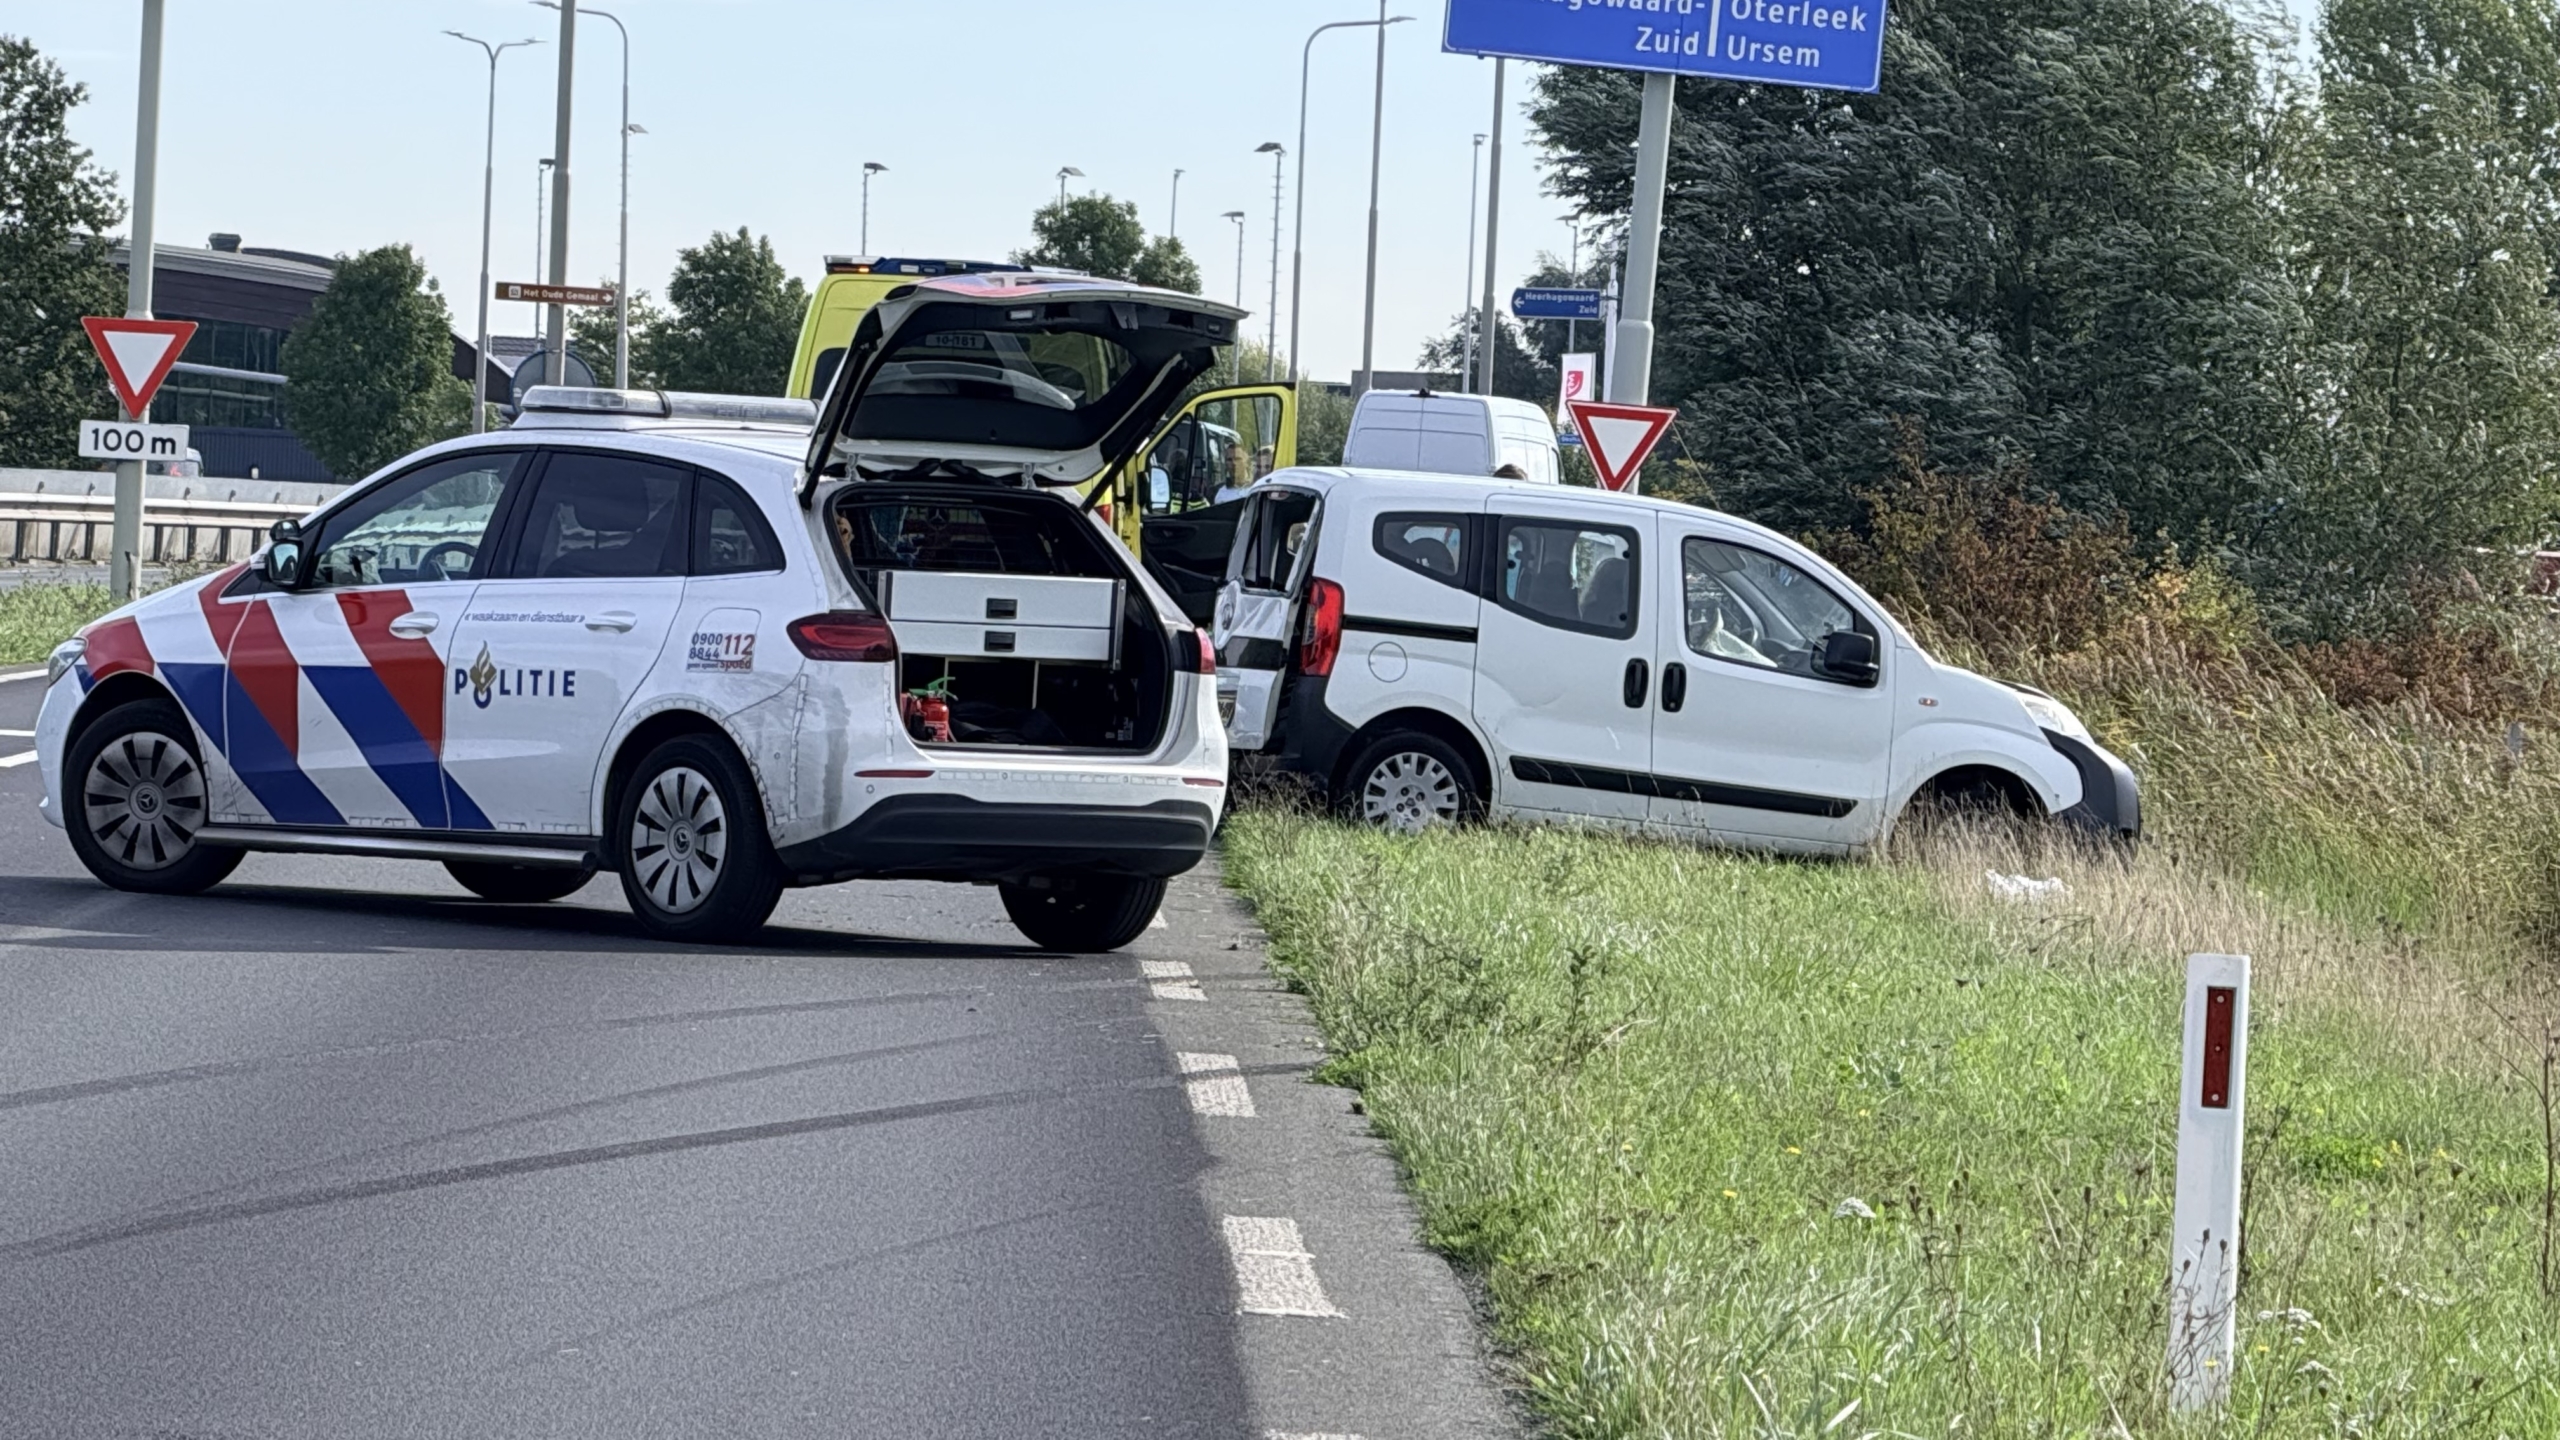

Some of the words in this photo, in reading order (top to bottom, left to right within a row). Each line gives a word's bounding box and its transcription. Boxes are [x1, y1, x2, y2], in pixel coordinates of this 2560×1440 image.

[1731, 0, 1868, 32] Oterleek
[1635, 26, 1699, 55] Zuid
[1727, 35, 1820, 68] Ursem
[523, 289, 539, 297] Het
[542, 289, 564, 299] Oude
[566, 291, 599, 302] Gemaal
[1578, 305, 1598, 314] Zuid
[92, 428, 144, 453] 100
[151, 437, 176, 455] m
[691, 632, 723, 646] 0900
[724, 634, 756, 655] 112
[689, 647, 720, 660] 8844
[454, 668, 576, 709] POLITIE
